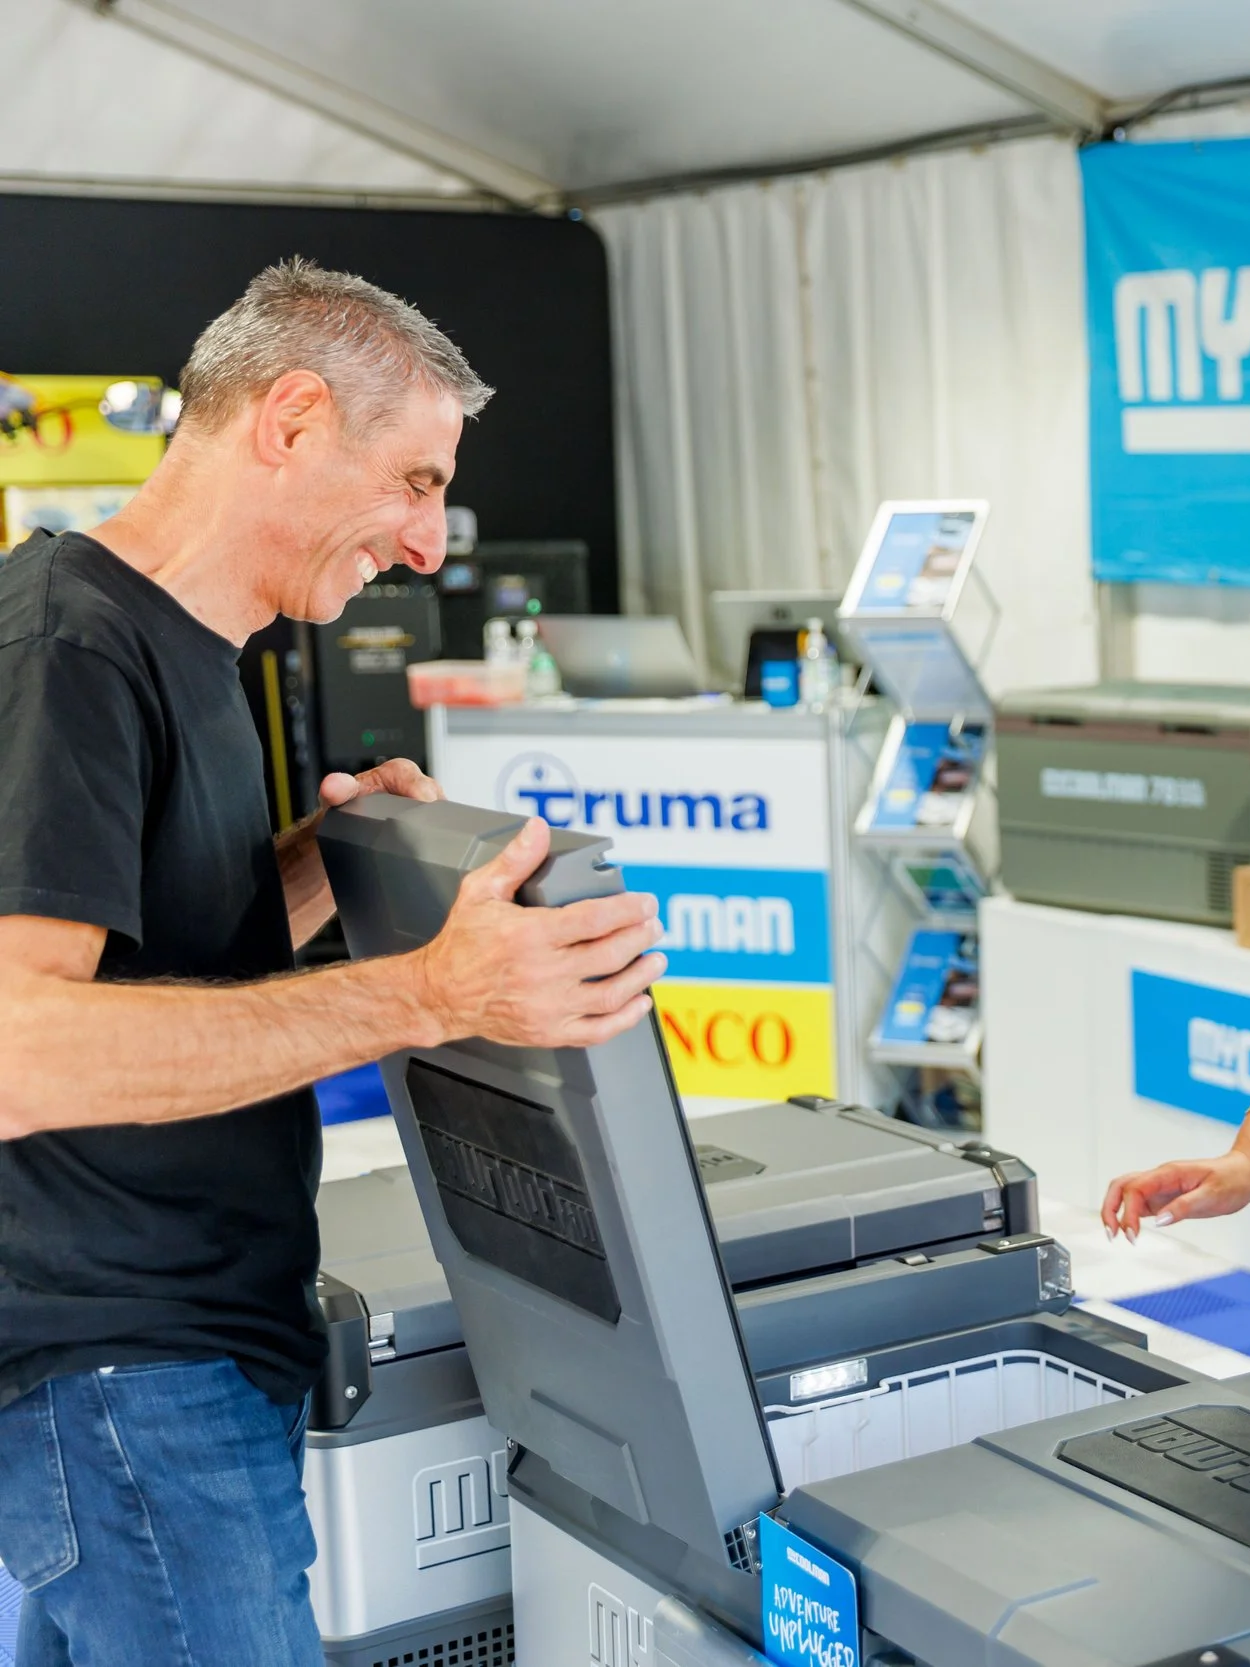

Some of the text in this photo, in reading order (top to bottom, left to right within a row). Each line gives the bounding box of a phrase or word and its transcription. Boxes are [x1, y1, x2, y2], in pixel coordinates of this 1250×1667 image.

[517, 786, 771, 832] truma
[658, 893, 796, 955] MAN
[774, 1584, 841, 1633] ADVENTURE
[768, 1611, 855, 1667] UNPLUGGED
